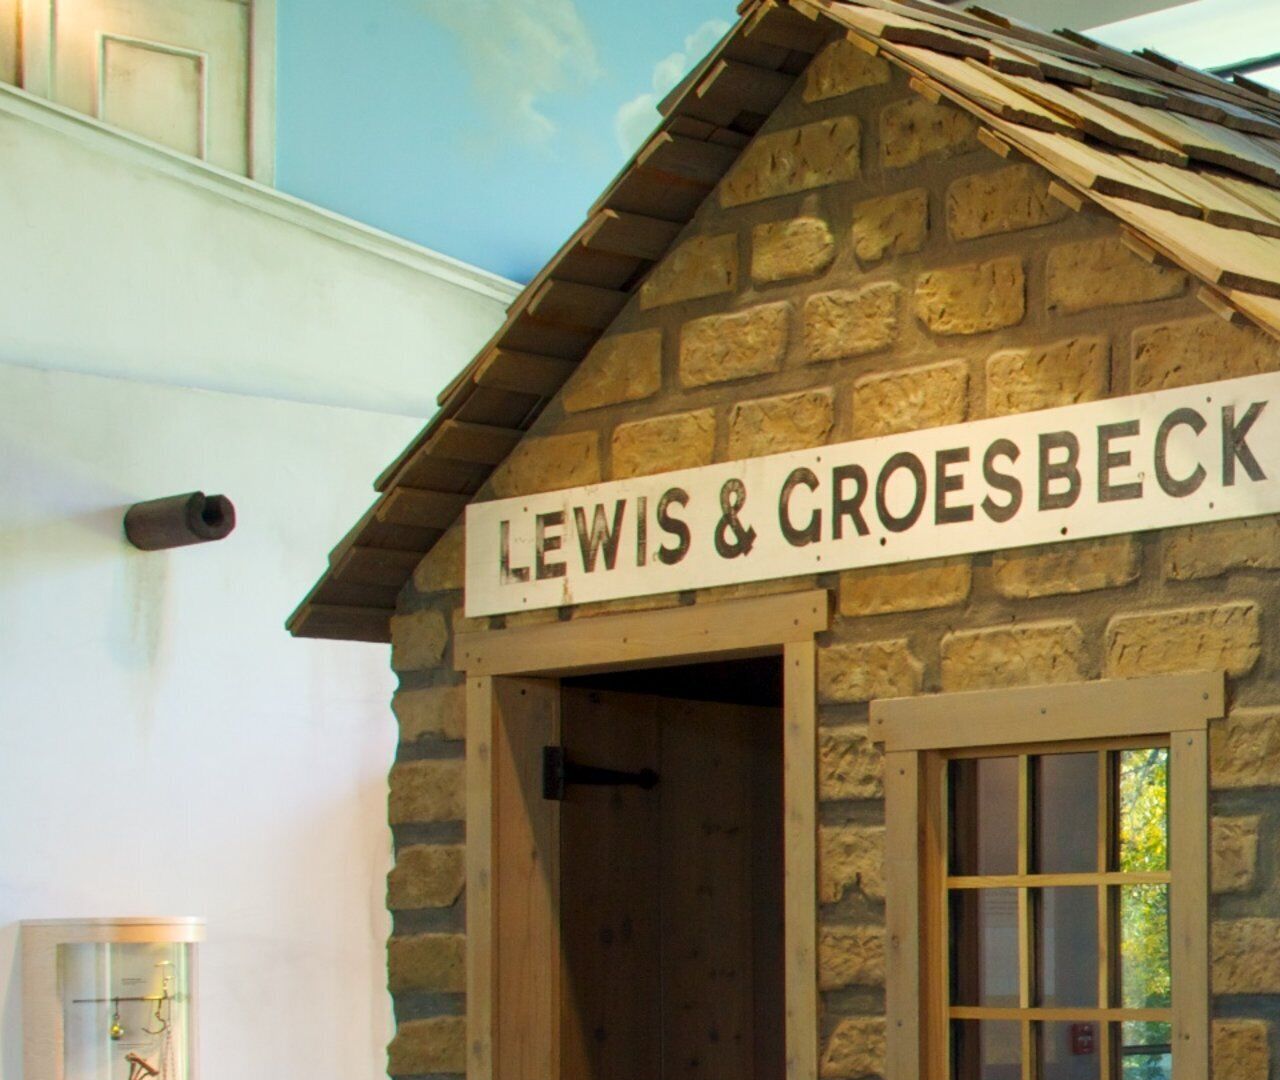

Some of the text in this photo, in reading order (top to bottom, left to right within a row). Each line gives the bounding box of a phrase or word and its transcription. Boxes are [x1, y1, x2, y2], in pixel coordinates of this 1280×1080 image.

[499, 400, 1270, 586] LEWIS & GROESBECK
